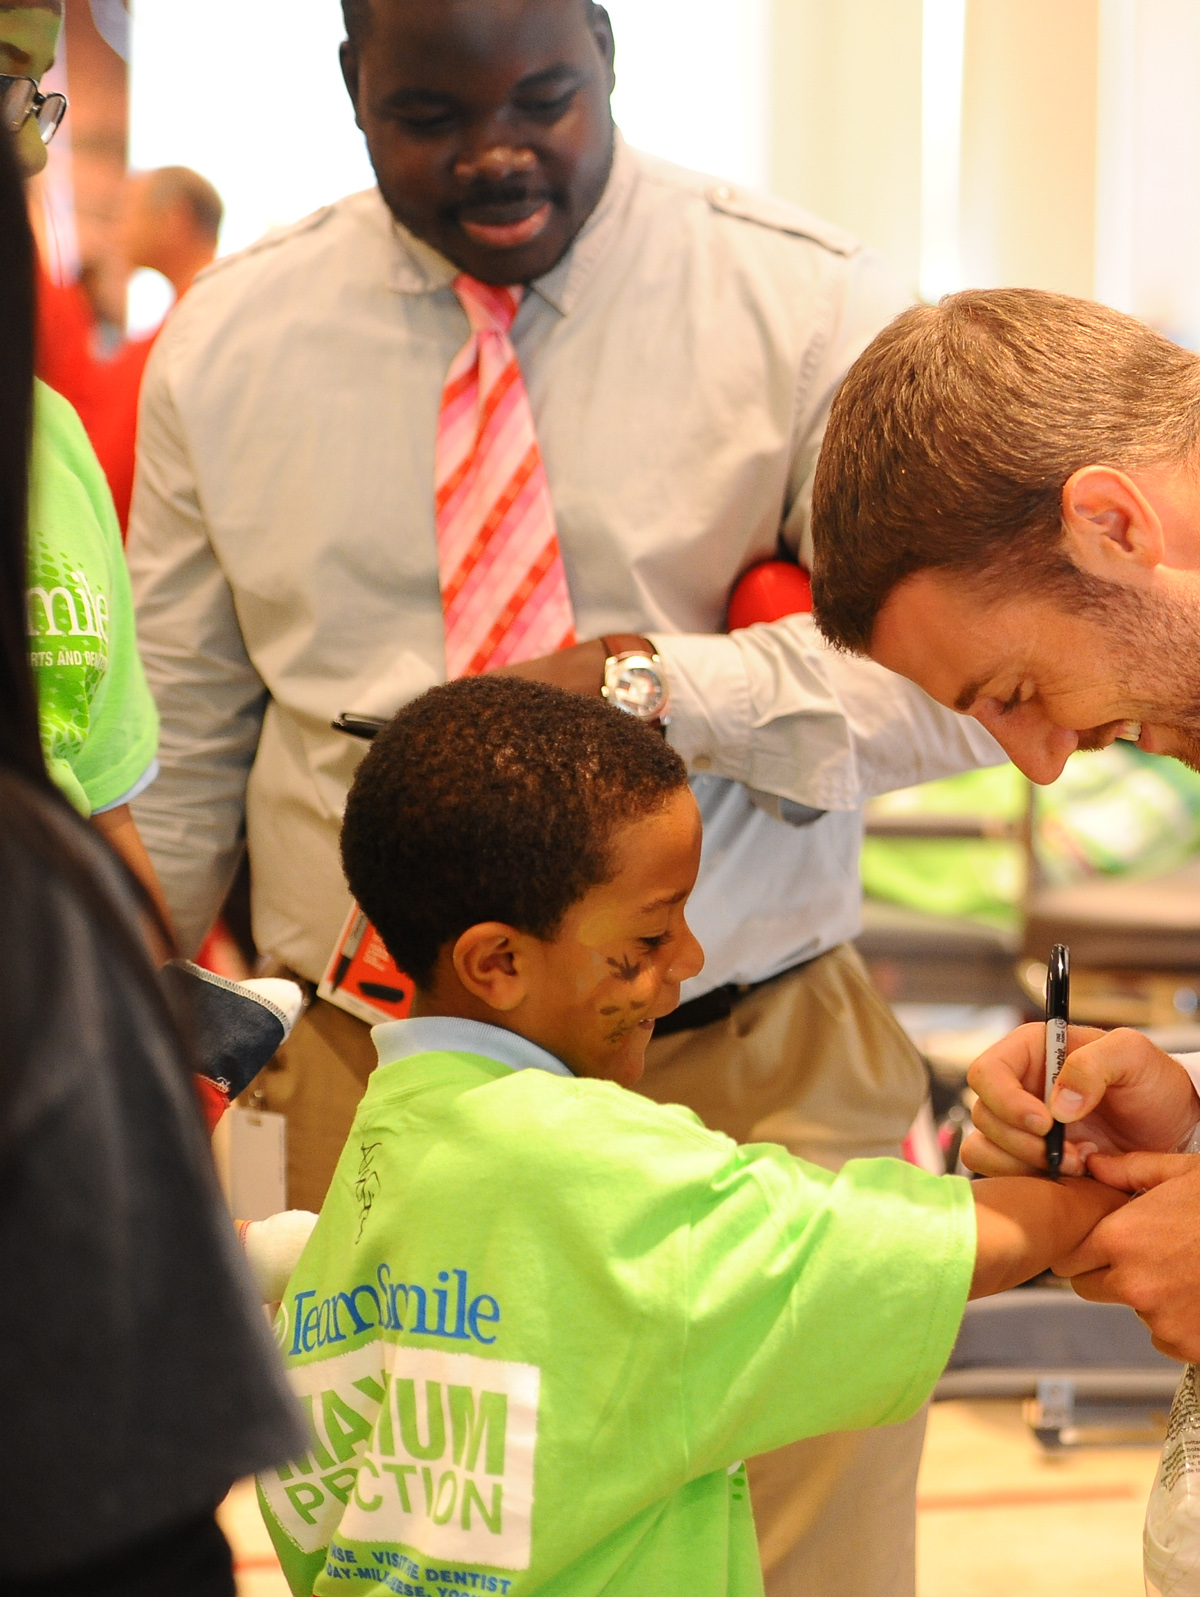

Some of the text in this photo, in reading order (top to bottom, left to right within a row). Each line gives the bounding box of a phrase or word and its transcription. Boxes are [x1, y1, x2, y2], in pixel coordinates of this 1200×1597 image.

[57, 650, 82, 666] AND
[288, 1263, 501, 1356] TeamSmile
[284, 1458, 503, 1534] PRCTION
[424, 1568, 512, 1595] DENTIST
